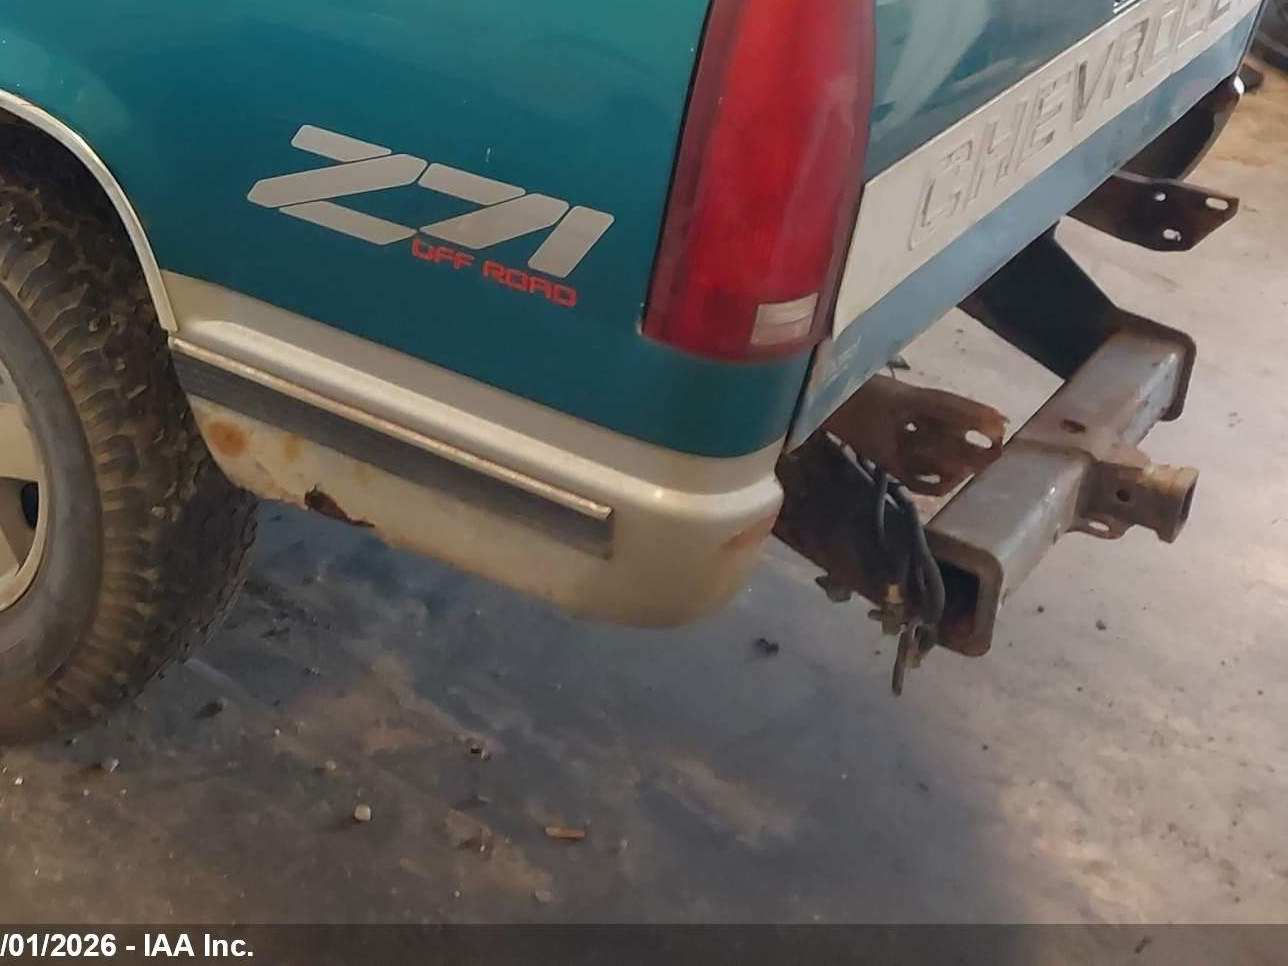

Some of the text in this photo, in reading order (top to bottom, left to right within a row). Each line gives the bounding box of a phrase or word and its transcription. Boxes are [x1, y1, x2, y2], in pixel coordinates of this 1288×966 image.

[246, 124, 616, 278] Z71
[412, 237, 578, 308] OFF ROAD
